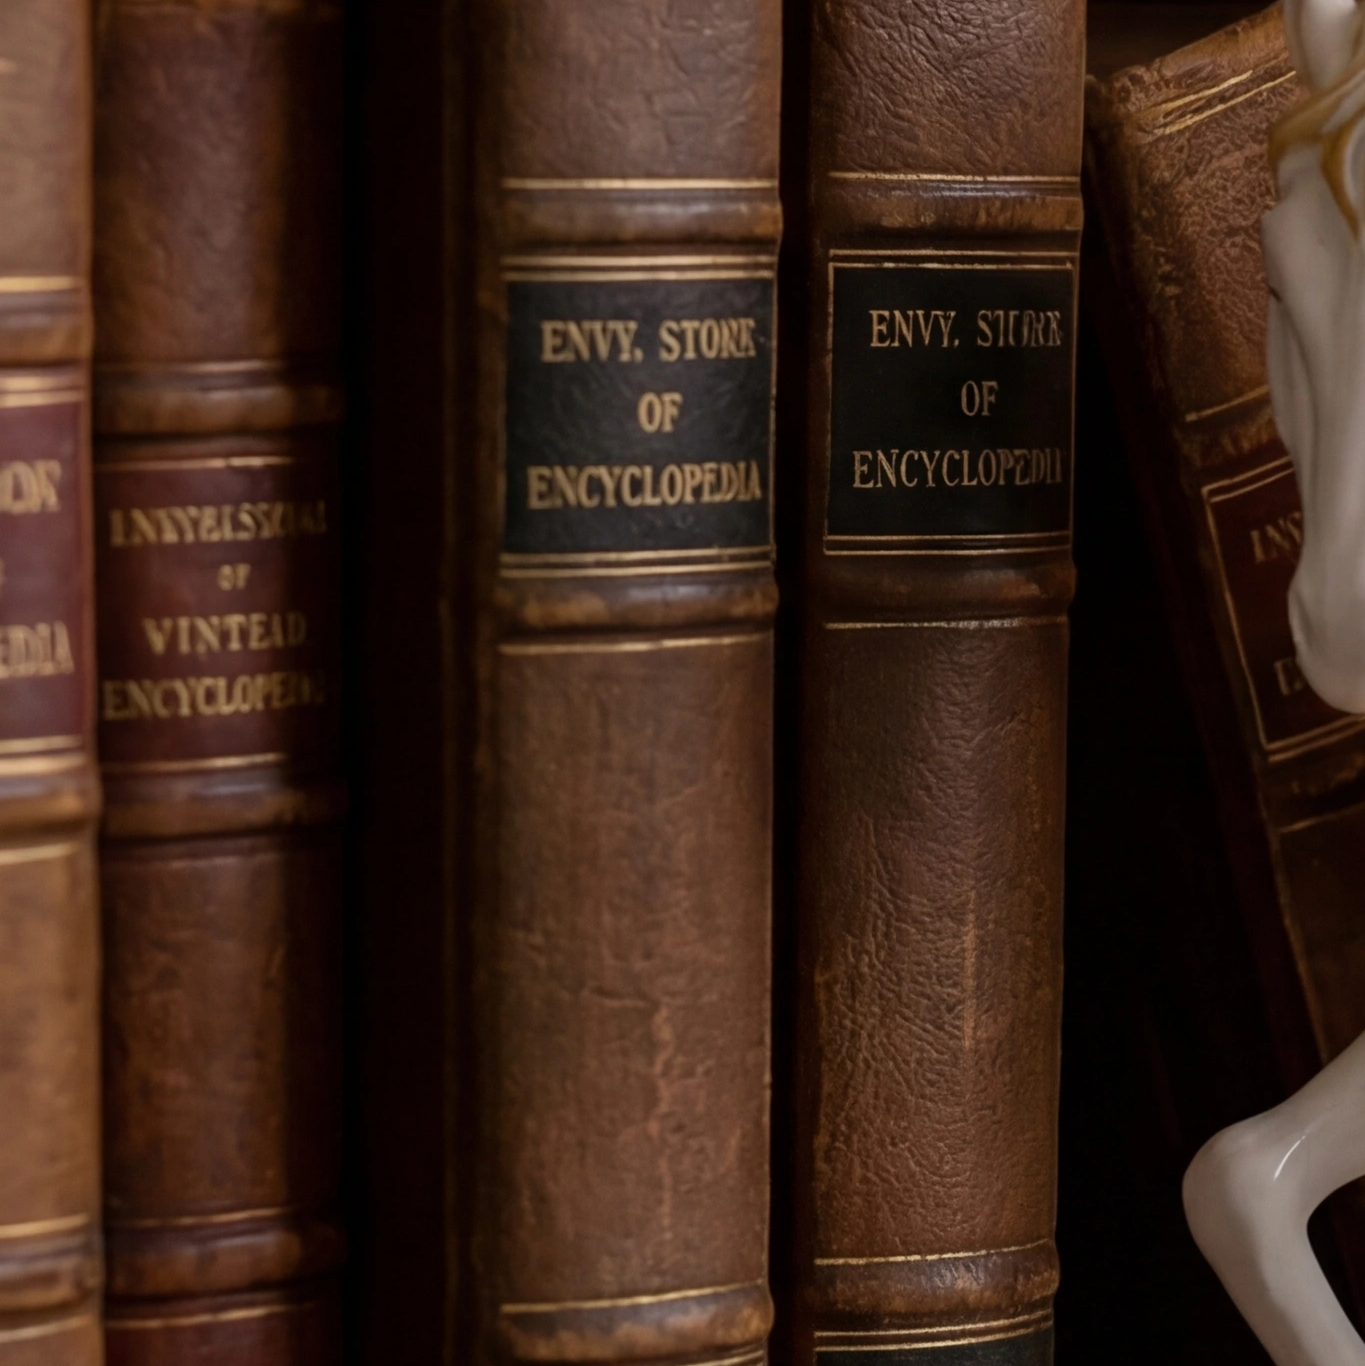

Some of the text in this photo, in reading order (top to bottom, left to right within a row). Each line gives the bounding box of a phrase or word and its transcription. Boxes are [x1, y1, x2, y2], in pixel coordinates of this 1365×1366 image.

[636, 391, 683, 434] OF
[960, 380, 999, 417] OF
[526, 460, 763, 511] ENCYCLOPEDIA
